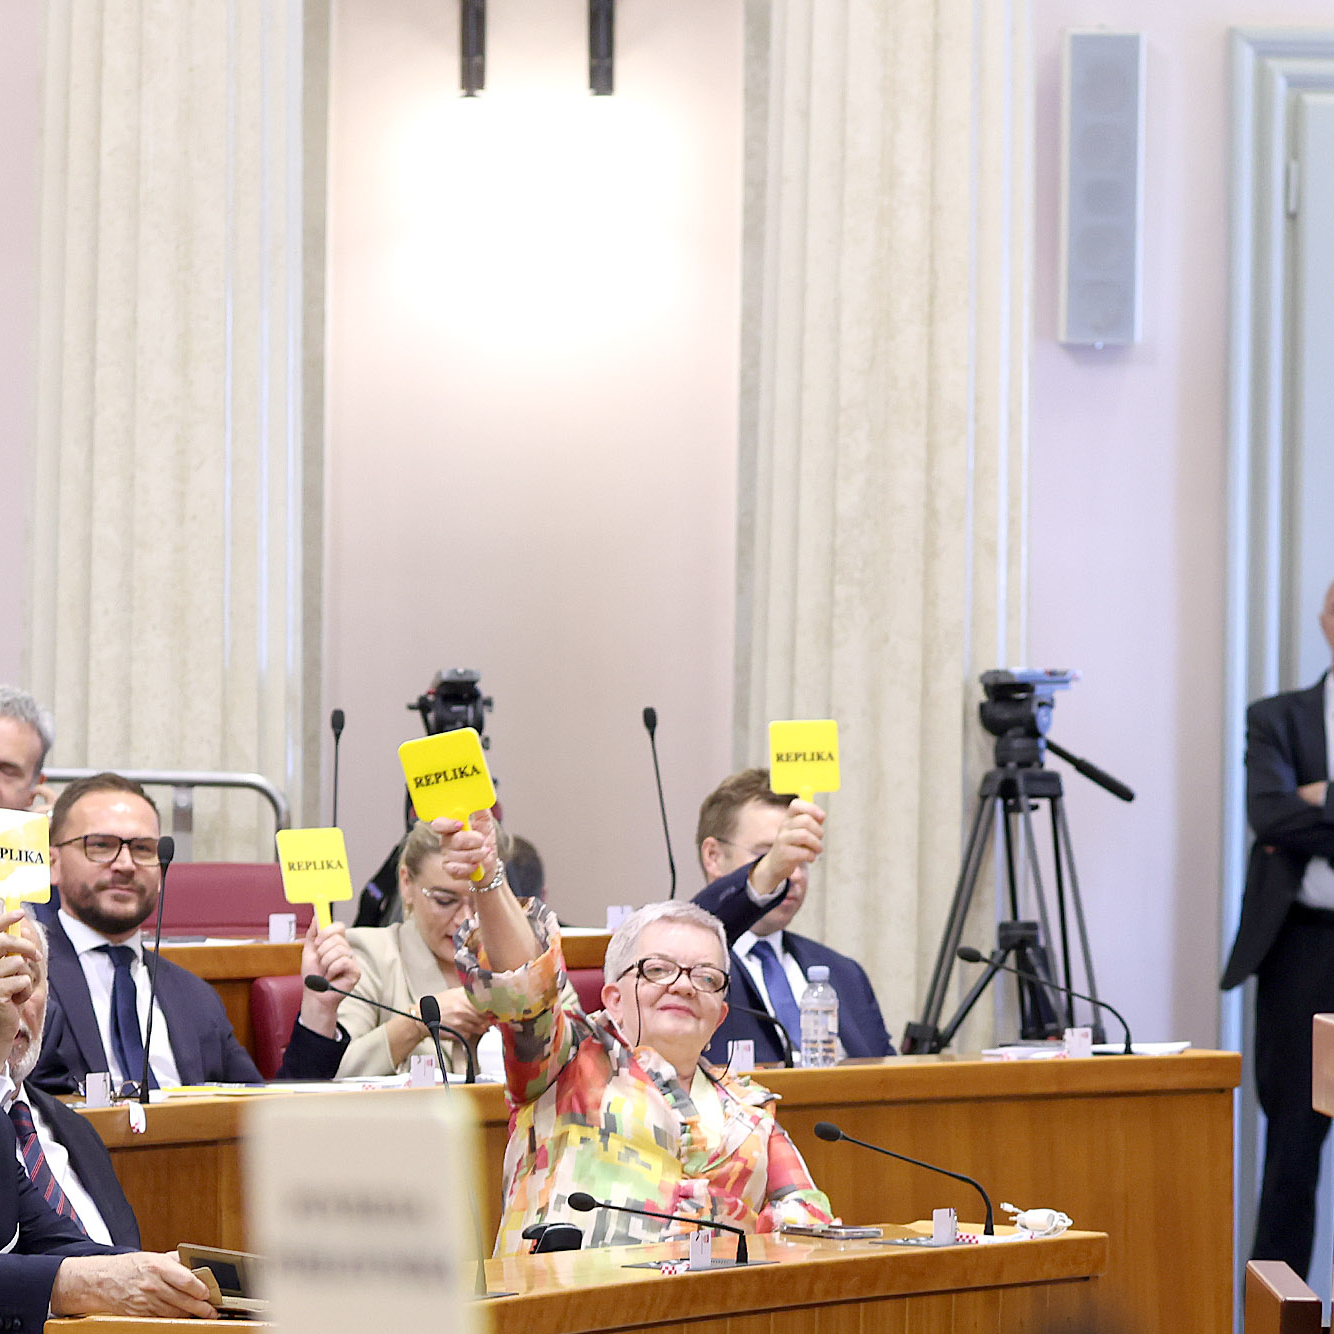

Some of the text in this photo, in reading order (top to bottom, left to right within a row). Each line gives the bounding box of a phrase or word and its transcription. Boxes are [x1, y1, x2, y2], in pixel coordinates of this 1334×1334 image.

[776, 751, 835, 763] REPLIKA
[413, 765, 482, 789] REPLIKA
[287, 859, 344, 872] REPLIKA
